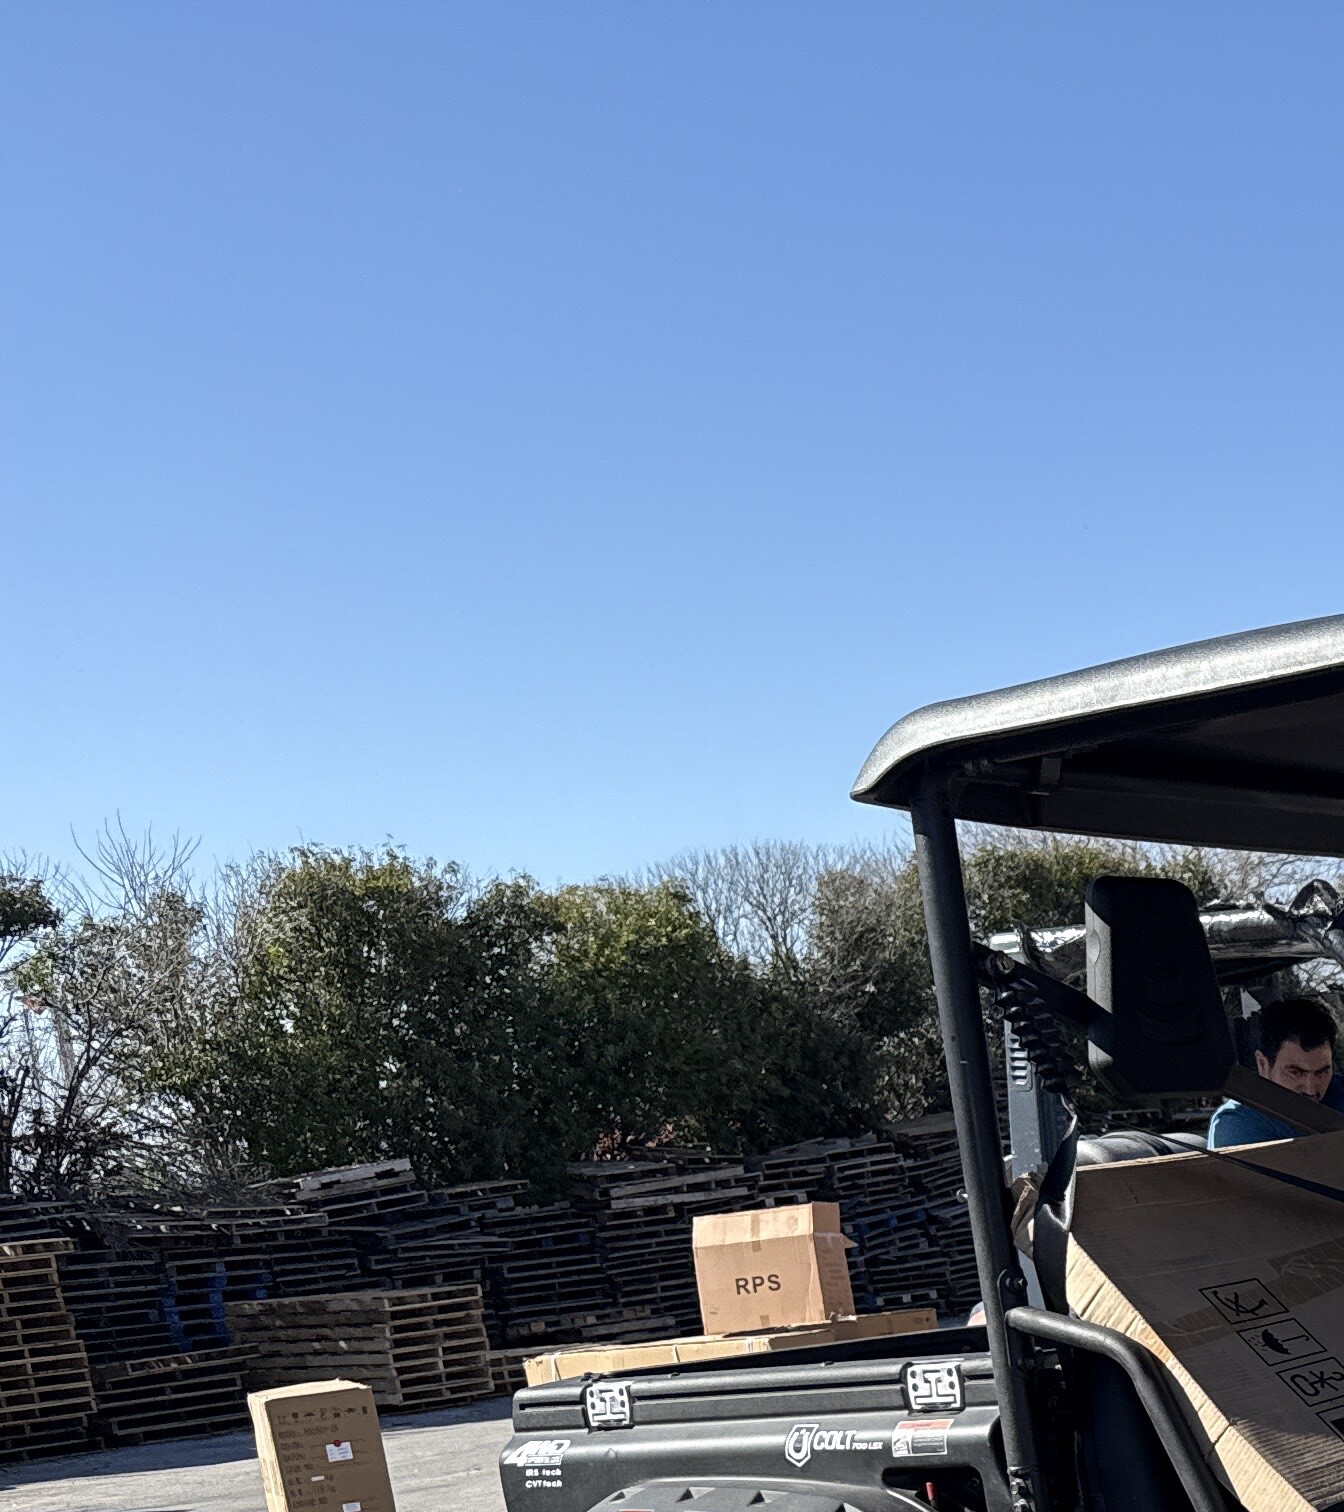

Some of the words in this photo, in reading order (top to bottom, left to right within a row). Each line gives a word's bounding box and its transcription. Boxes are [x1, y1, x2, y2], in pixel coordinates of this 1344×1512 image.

[734, 1273, 782, 1296] RPS
[813, 1430, 858, 1450] COLT
[503, 1439, 571, 1467] 4WD
